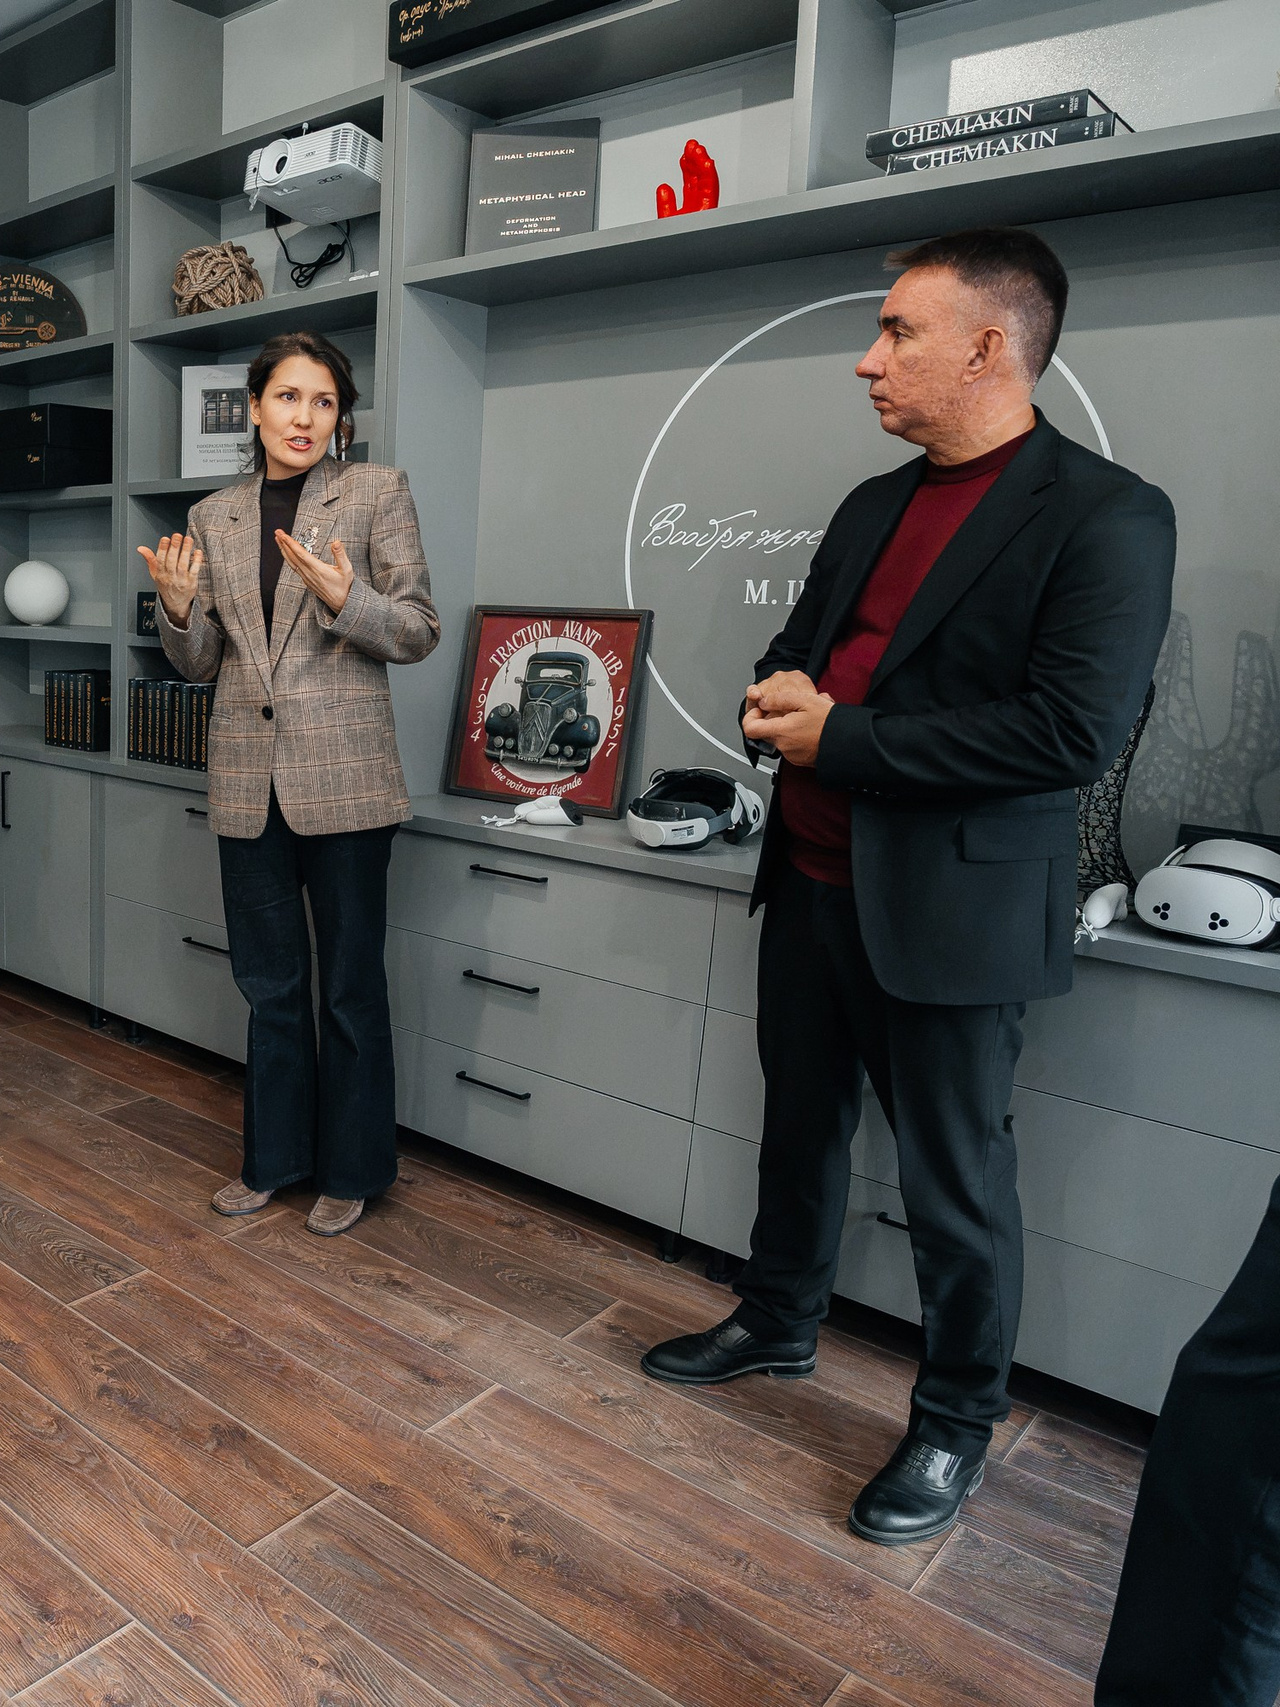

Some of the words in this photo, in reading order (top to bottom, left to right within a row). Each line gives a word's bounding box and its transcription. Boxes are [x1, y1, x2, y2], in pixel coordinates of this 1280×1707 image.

[891, 103, 1035, 148] CHEMIAKIN
[494, 152, 524, 161] MIHAIL
[526, 148, 575, 158] CHEMIAKIN
[912, 128, 1059, 171] CHEMIAKIN
[317, 173, 343, 185] acer
[479, 193, 555, 205] METAPHYSICAL
[558, 190, 587, 198] HEAD
[500, 227, 561, 236] METAMORPHOSIS
[506, 216, 556, 224] DEFORMATION
[641, 503, 824, 572] Воображае
[744, 579, 778, 605] М.
[488, 619, 552, 668] TRACTION
[561, 620, 602, 649] AVANT
[601, 649, 624, 677] 11B
[490, 763, 504, 782] Une
[506, 778, 536, 796] voiture
[536, 785, 548, 796] de
[549, 777, 583, 797] légende
